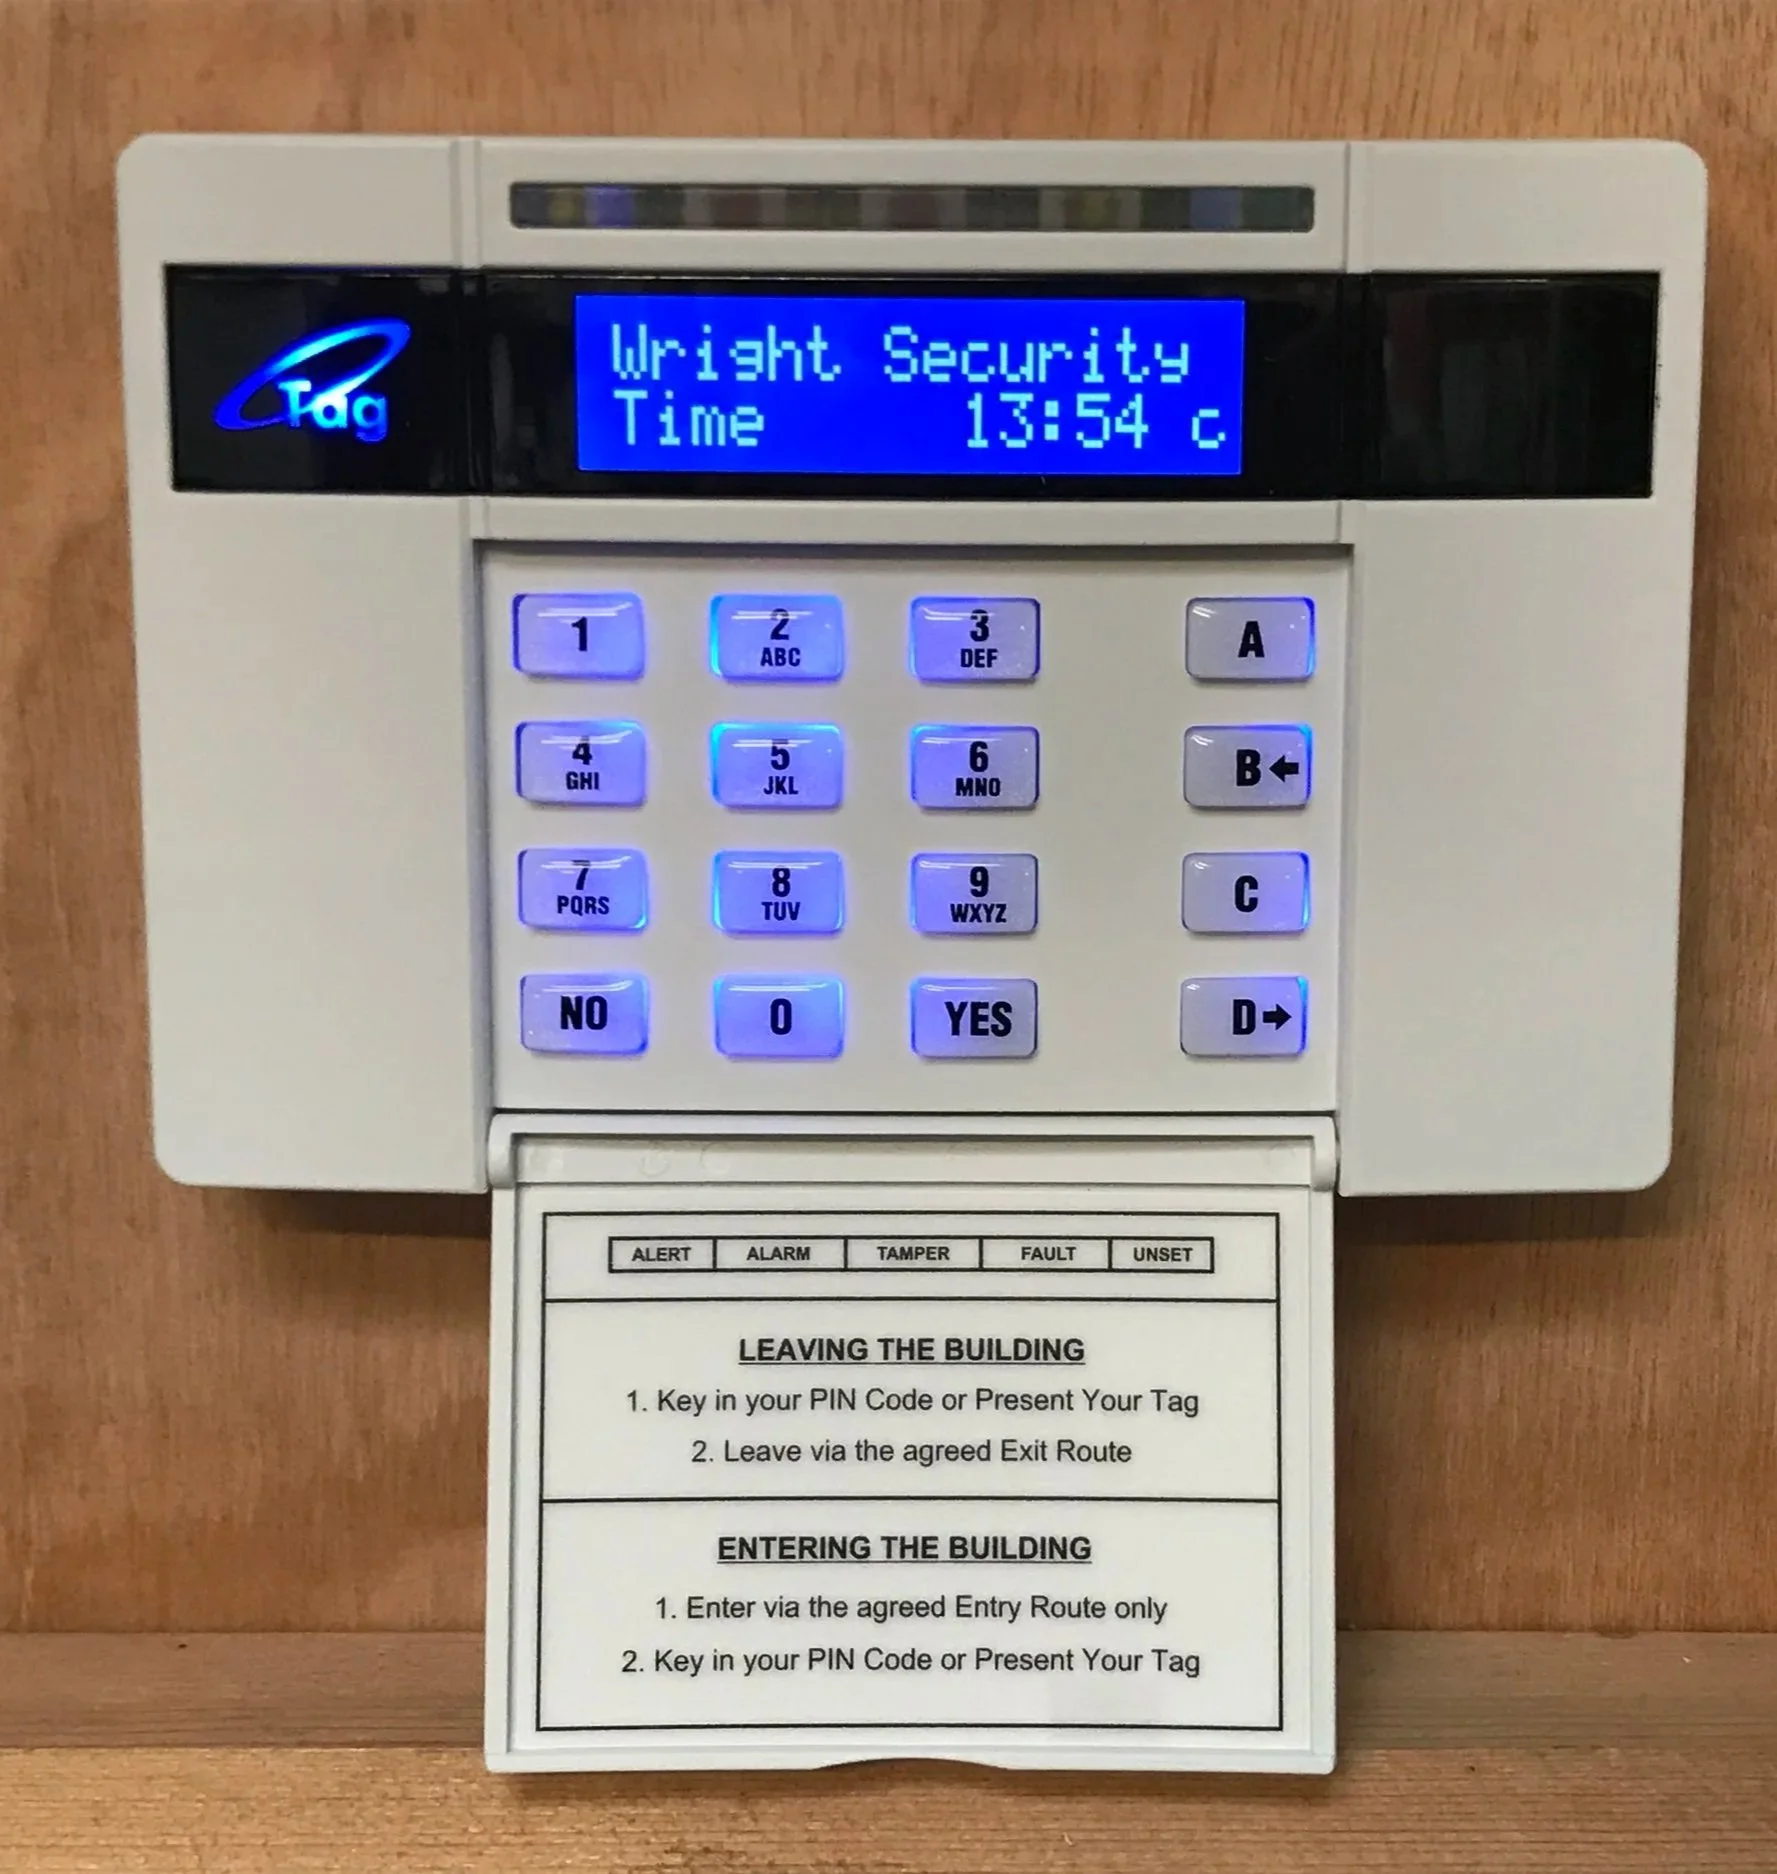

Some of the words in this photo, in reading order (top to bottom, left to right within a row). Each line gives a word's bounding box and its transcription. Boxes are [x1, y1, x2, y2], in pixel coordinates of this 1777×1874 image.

[611, 323, 842, 382] Wright
[883, 325, 1189, 384] Security
[280, 380, 388, 442] Tag
[613, 389, 765, 447] Time
[967, 392, 1149, 449] 13:54
[1191, 408, 1226, 449] c
[572, 616, 588, 651] 1
[770, 608, 789, 640] 2
[970, 608, 990, 642] 3
[1237, 620, 1266, 659] A
[760, 647, 800, 667] ABC
[960, 648, 999, 669] DEF
[572, 736, 593, 766] 4
[771, 738, 790, 771] 5
[969, 740, 990, 773] 6
[565, 771, 599, 790] GHI
[1235, 748, 1262, 787] B
[763, 776, 798, 795] JKL
[955, 777, 1002, 798] MNO
[573, 859, 589, 891] 7
[772, 867, 791, 898] 8
[969, 865, 990, 898] 9
[557, 895, 609, 916] PQRS
[1234, 874, 1259, 913] C
[762, 901, 800, 921] TUV
[950, 902, 1008, 924] WXYZ
[560, 995, 608, 1031] NO
[944, 1000, 1013, 1038] YES
[1232, 998, 1257, 1036] D
[631, 1246, 692, 1262] ALERT
[746, 1246, 811, 1262] ALARM
[876, 1245, 951, 1261] TAMPER
[1021, 1246, 1077, 1262] FAULT
[1133, 1246, 1194, 1263] UNSET
[739, 1337, 869, 1362] LEAVING
[876, 1337, 935, 1361] THE
[944, 1337, 1085, 1362] BUILDING
[627, 1389, 647, 1412] 1.
[657, 1388, 707, 1418] Key
[715, 1388, 737, 1411] in
[745, 1393, 803, 1417] your
[810, 1387, 856, 1411] PIN
[865, 1387, 934, 1411] Code
[941, 1393, 968, 1411] or
[975, 1387, 1074, 1411] Present
[1081, 1388, 1143, 1412] Your
[1150, 1389, 1199, 1419] Tag
[691, 1439, 714, 1463] 2.
[724, 1439, 802, 1463] Leave
[810, 1439, 846, 1462] via
[854, 1439, 895, 1462] the
[902, 1439, 991, 1468] agreed
[1001, 1438, 1048, 1462] Exit
[1056, 1439, 1132, 1463] Route
[718, 1535, 871, 1562] ENTERING
[880, 1535, 939, 1562] THE
[947, 1535, 1092, 1562] BUILDING
[656, 1596, 677, 1619] 1.
[687, 1595, 757, 1619] Enter
[763, 1595, 800, 1619] via
[808, 1595, 849, 1619] the
[856, 1594, 946, 1624] agreed
[955, 1594, 1022, 1624] Entry
[1030, 1595, 1107, 1619] Route
[1114, 1596, 1168, 1626] only
[621, 1649, 644, 1673] 2.
[654, 1649, 704, 1678] Key
[712, 1648, 734, 1672] in
[743, 1653, 801, 1677] your
[808, 1647, 855, 1671] PIN
[864, 1646, 933, 1671] Code
[940, 1653, 967, 1671] or
[975, 1647, 1075, 1672] Present
[1082, 1647, 1144, 1672] Your
[1151, 1648, 1200, 1679] Tag
